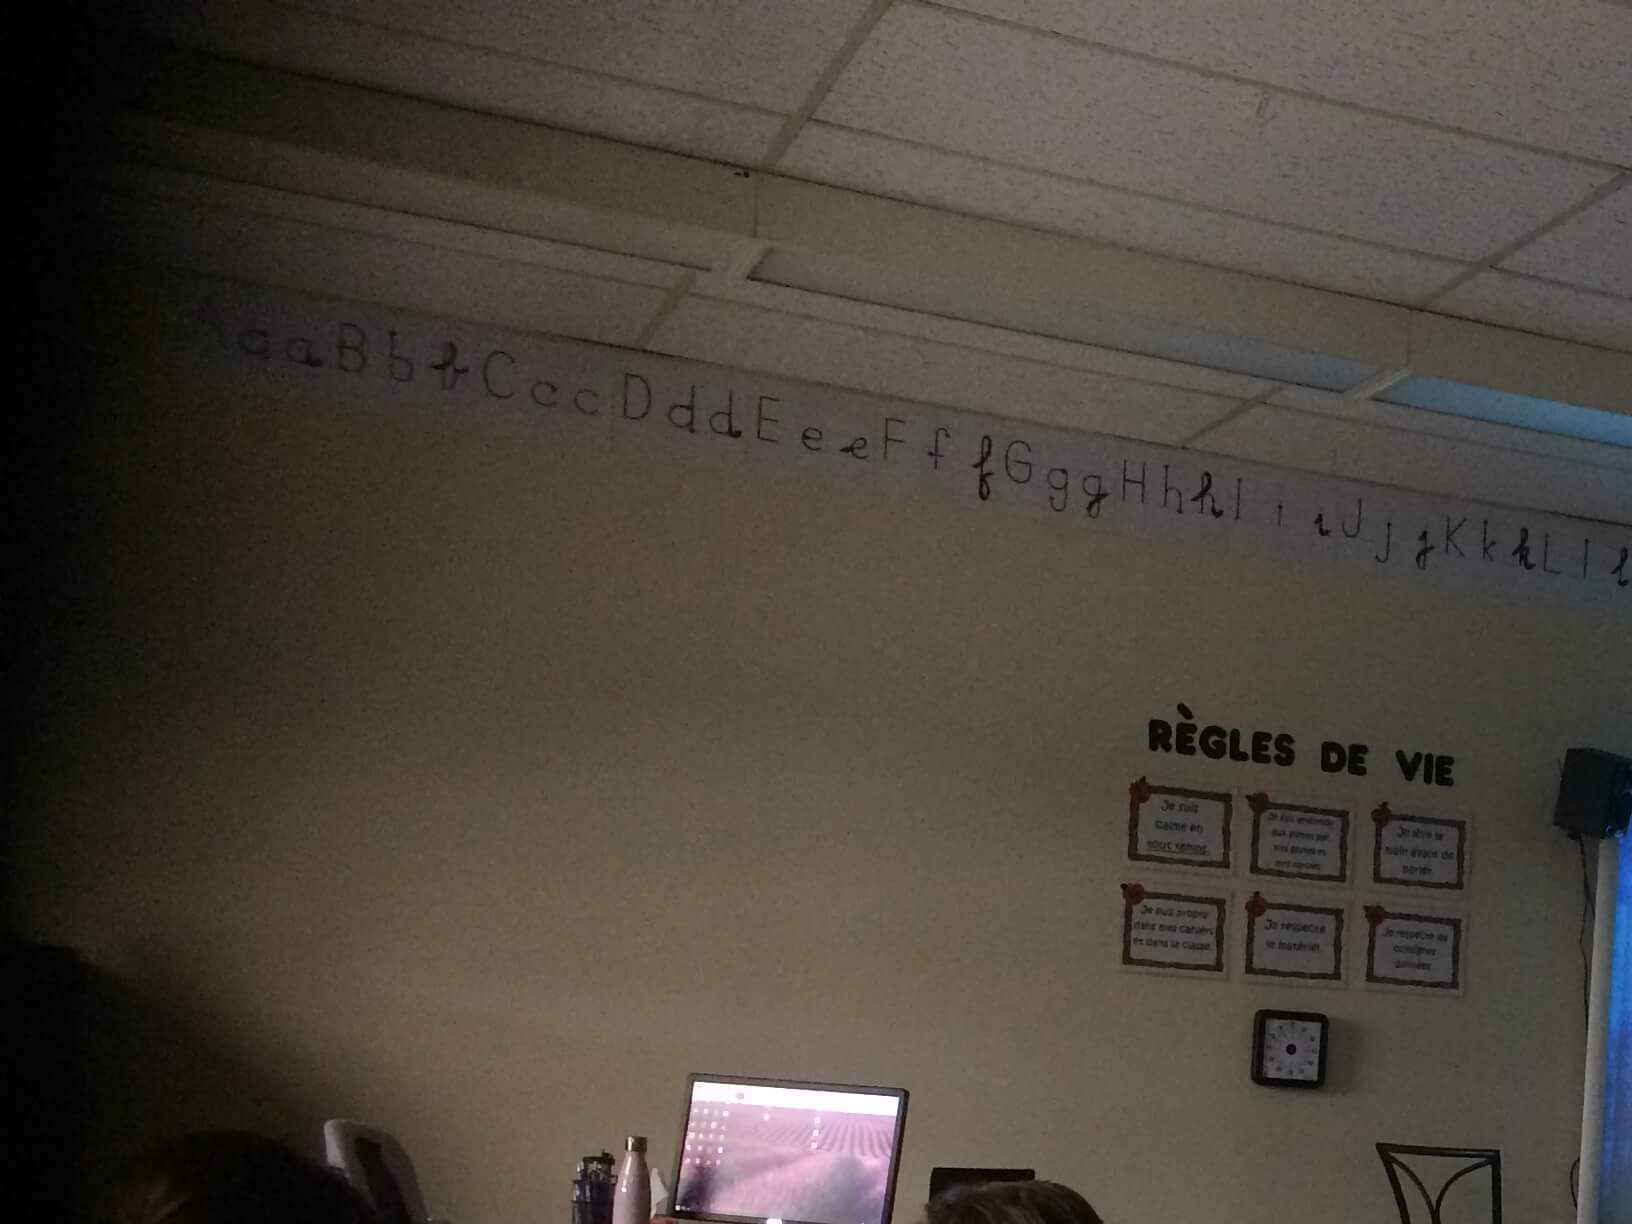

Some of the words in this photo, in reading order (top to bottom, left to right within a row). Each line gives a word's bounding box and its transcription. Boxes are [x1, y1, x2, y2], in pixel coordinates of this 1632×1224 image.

[1148, 703, 1296, 767] RÈGLES
[1320, 741, 1369, 776] DE
[1395, 750, 1456, 787] VIE
